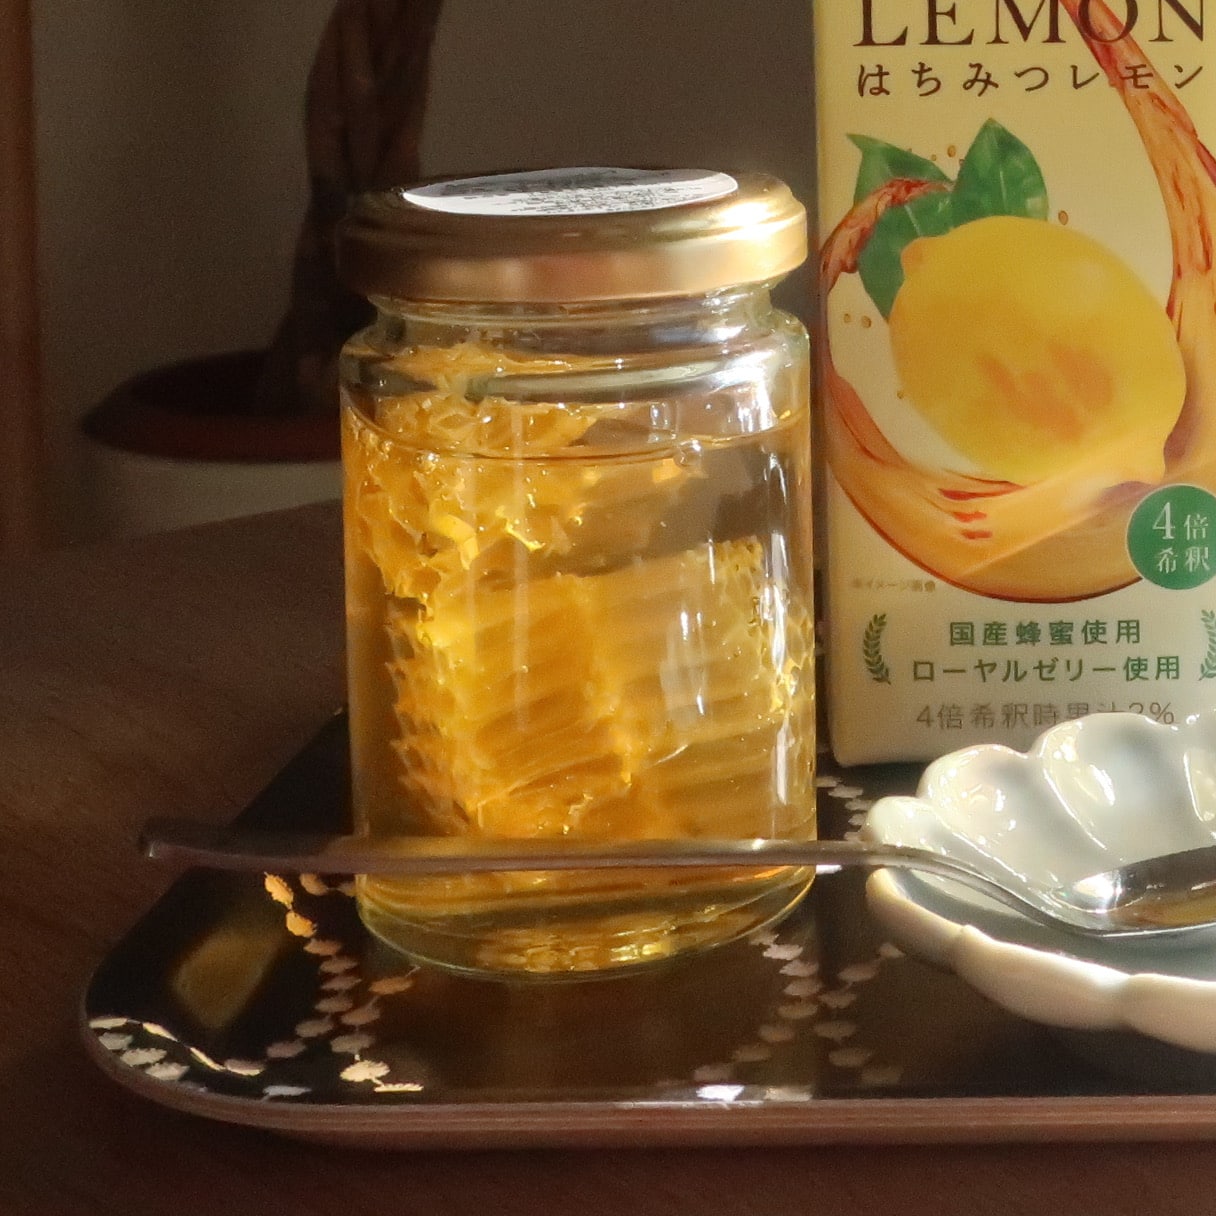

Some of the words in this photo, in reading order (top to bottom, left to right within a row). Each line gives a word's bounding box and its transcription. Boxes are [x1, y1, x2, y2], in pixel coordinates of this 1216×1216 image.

[857, 61, 1204, 97] はちみつレモン
[1152, 501, 1209, 541] 4倍
[1156, 547, 1211, 574] 希釈
[949, 618, 1141, 647] 国産蜂蜜使用
[912, 655, 1181, 683] ローヤルゼリー使用
